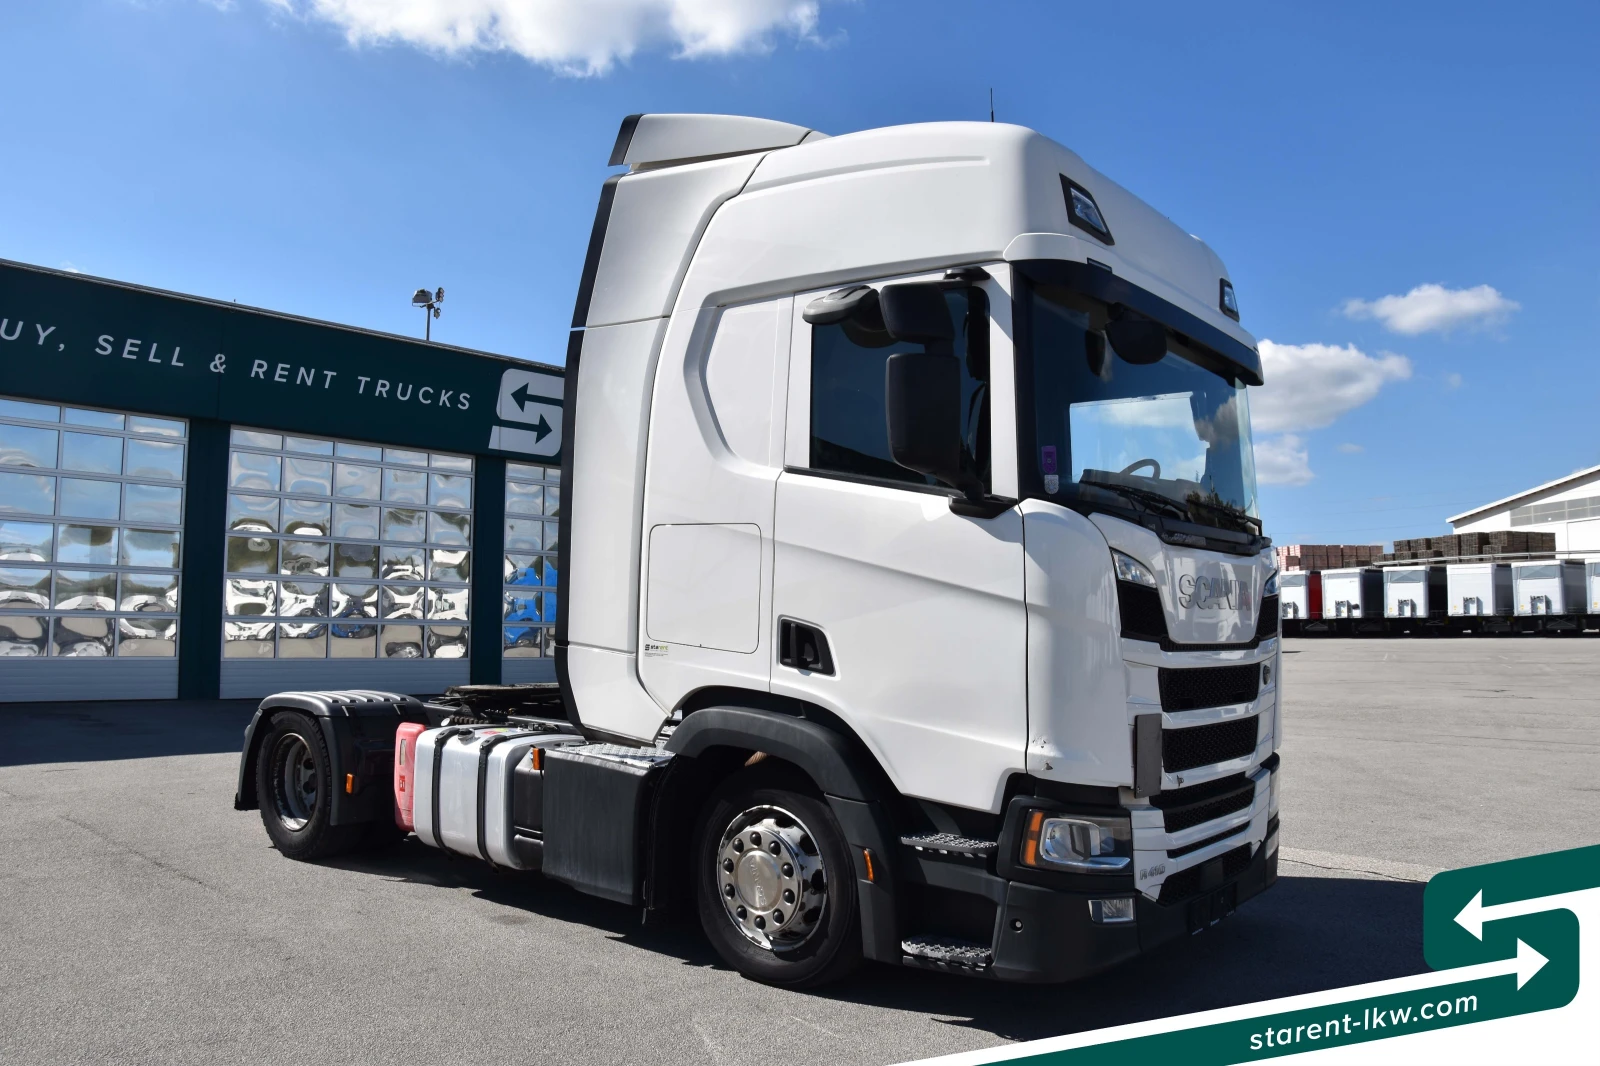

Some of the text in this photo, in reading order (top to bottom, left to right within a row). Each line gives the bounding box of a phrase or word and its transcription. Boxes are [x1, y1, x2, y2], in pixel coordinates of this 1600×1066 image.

[95, 334, 185, 367] SELL
[209, 353, 227, 374] &
[250, 359, 337, 389] RENT
[357, 376, 471, 410] TRUCKS
[1179, 573, 1251, 611] SCANIA
